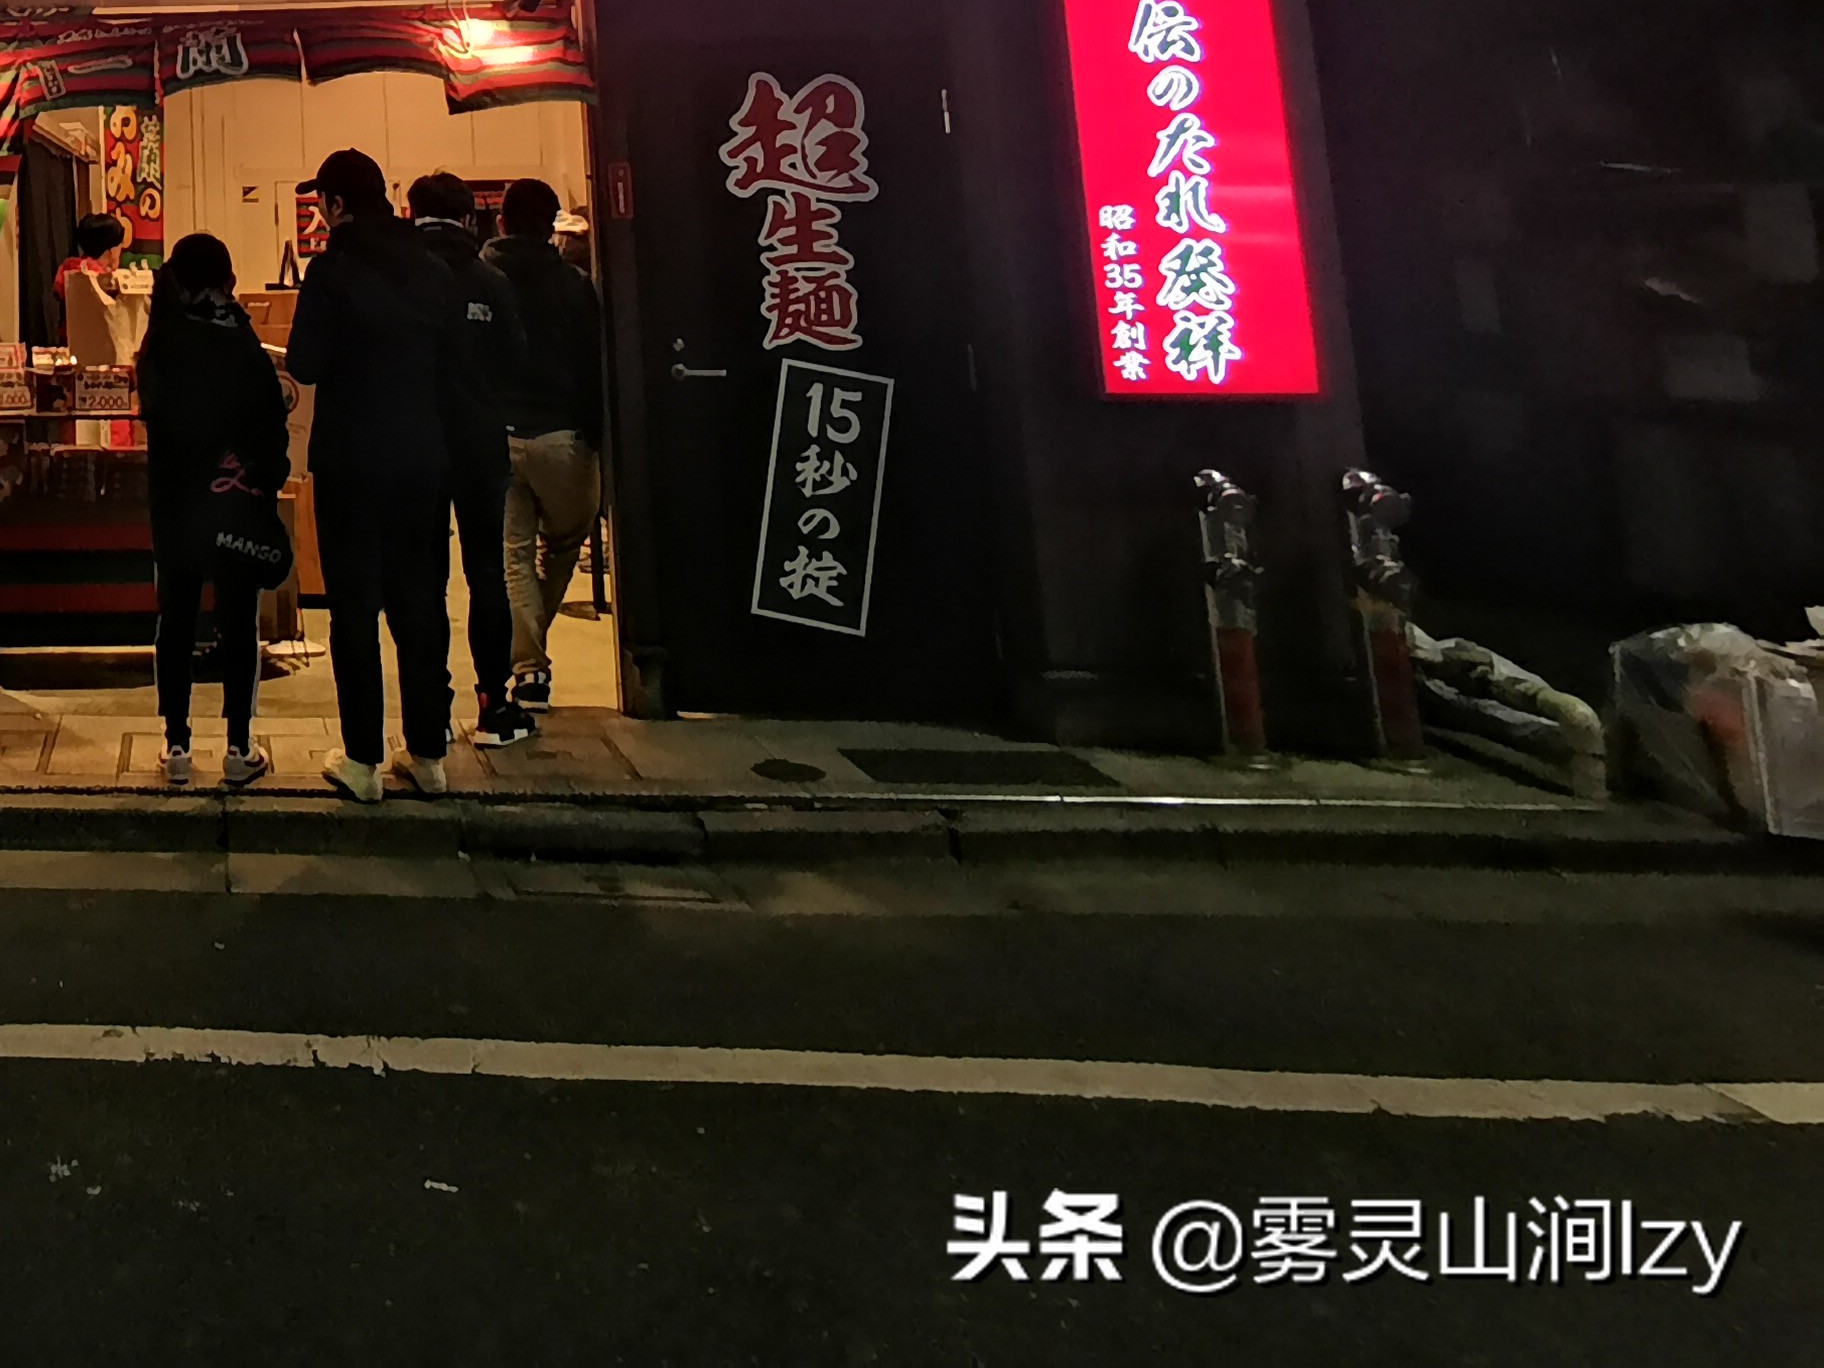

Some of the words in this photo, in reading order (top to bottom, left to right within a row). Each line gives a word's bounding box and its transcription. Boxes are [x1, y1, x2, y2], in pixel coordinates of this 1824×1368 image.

[719, 72, 879, 351] 超生麺
[1099, 204, 1152, 381] 昭和35年創業
[779, 382, 865, 608] 15秒の掟
